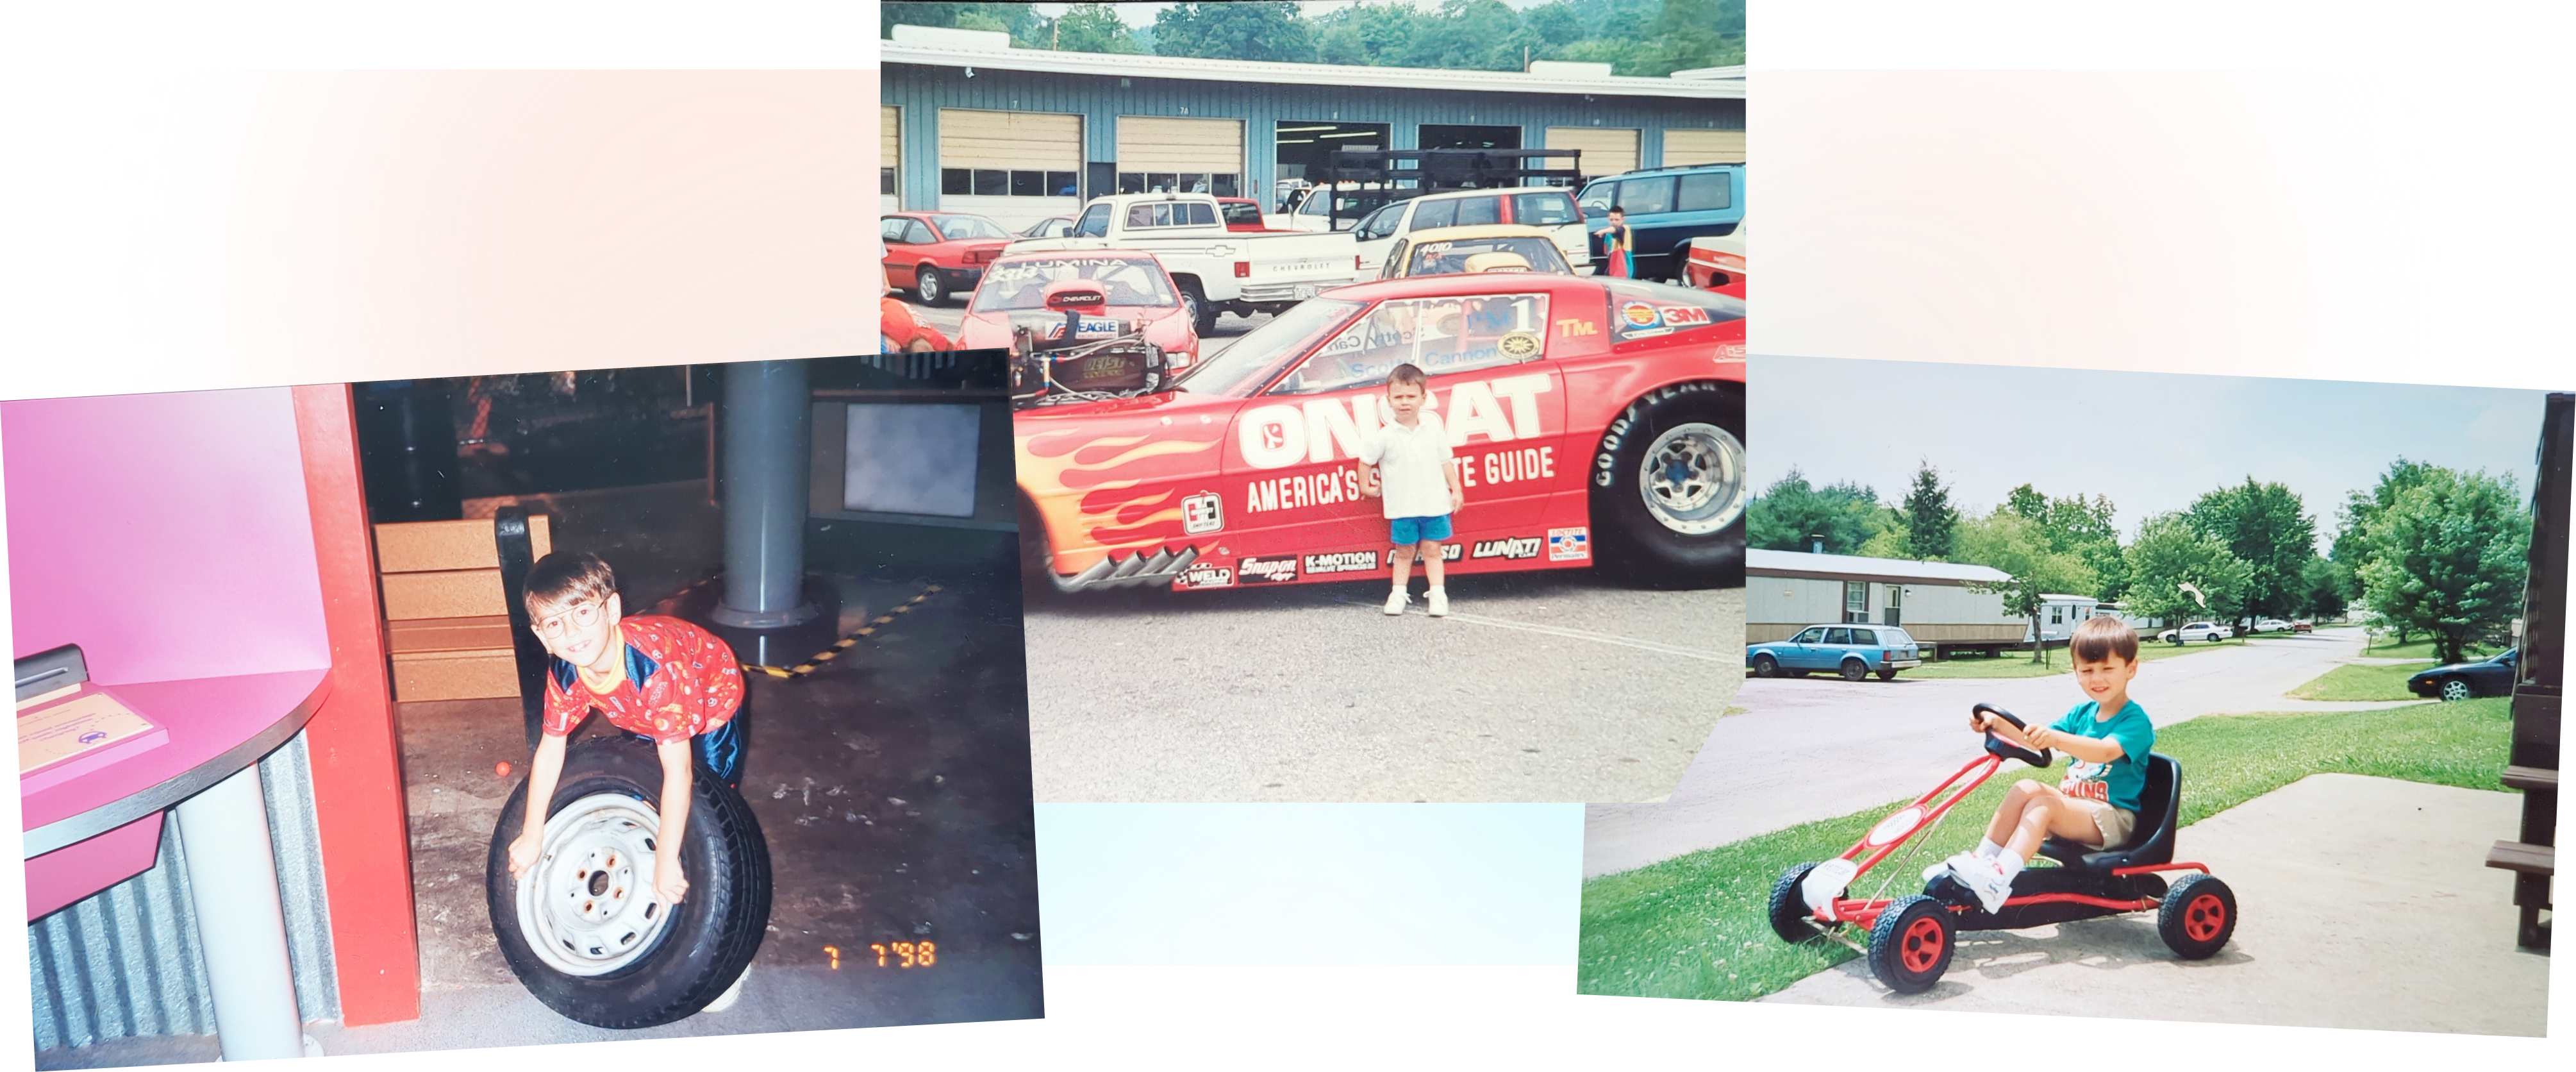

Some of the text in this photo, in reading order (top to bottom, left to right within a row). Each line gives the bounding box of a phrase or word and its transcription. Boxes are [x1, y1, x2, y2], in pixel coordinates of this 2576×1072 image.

[1020, 259, 1128, 269] LUMINA
[1273, 262, 1329, 272] CHEVROLET
[1510, 299, 1536, 332] 1
[1663, 308, 1708, 323] 3M
[1077, 322, 1117, 333] EAGLE
[1425, 347, 1497, 367] Cannon
[1484, 447, 1555, 485] GUIDE
[1247, 465, 1359, 514] AMERICA'S
[1552, 528, 1583, 536] LOCTITE
[1472, 537, 1541, 559] LUNATI
[1305, 551, 1376, 567] K-MOTION
[1189, 569, 1231, 583] WELD
